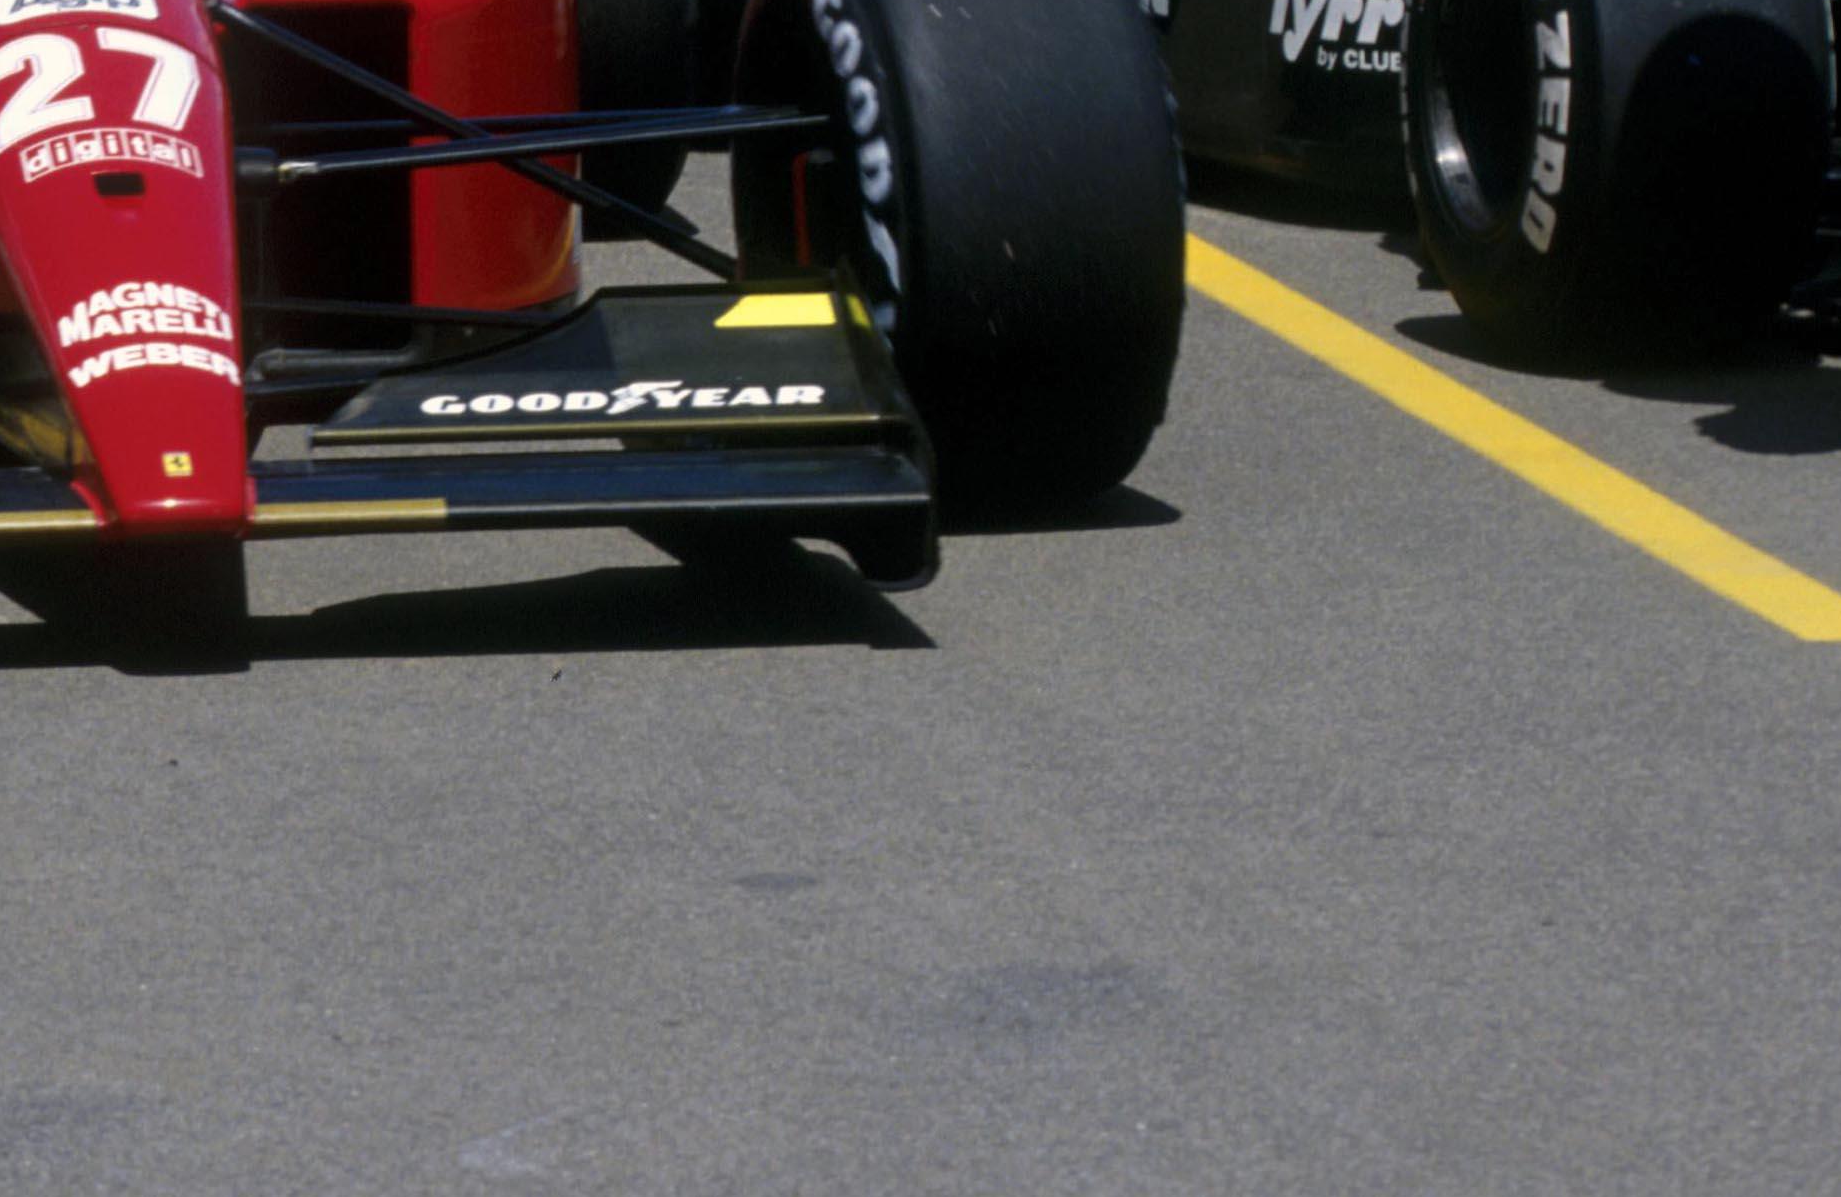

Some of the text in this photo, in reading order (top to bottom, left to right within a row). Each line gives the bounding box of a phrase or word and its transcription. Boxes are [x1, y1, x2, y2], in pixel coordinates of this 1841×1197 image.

[1316, 45, 1339, 71] by
[23, 129, 203, 182] digital
[67, 342, 242, 387] WEBER
[420, 383, 825, 416] GOODYEAR
